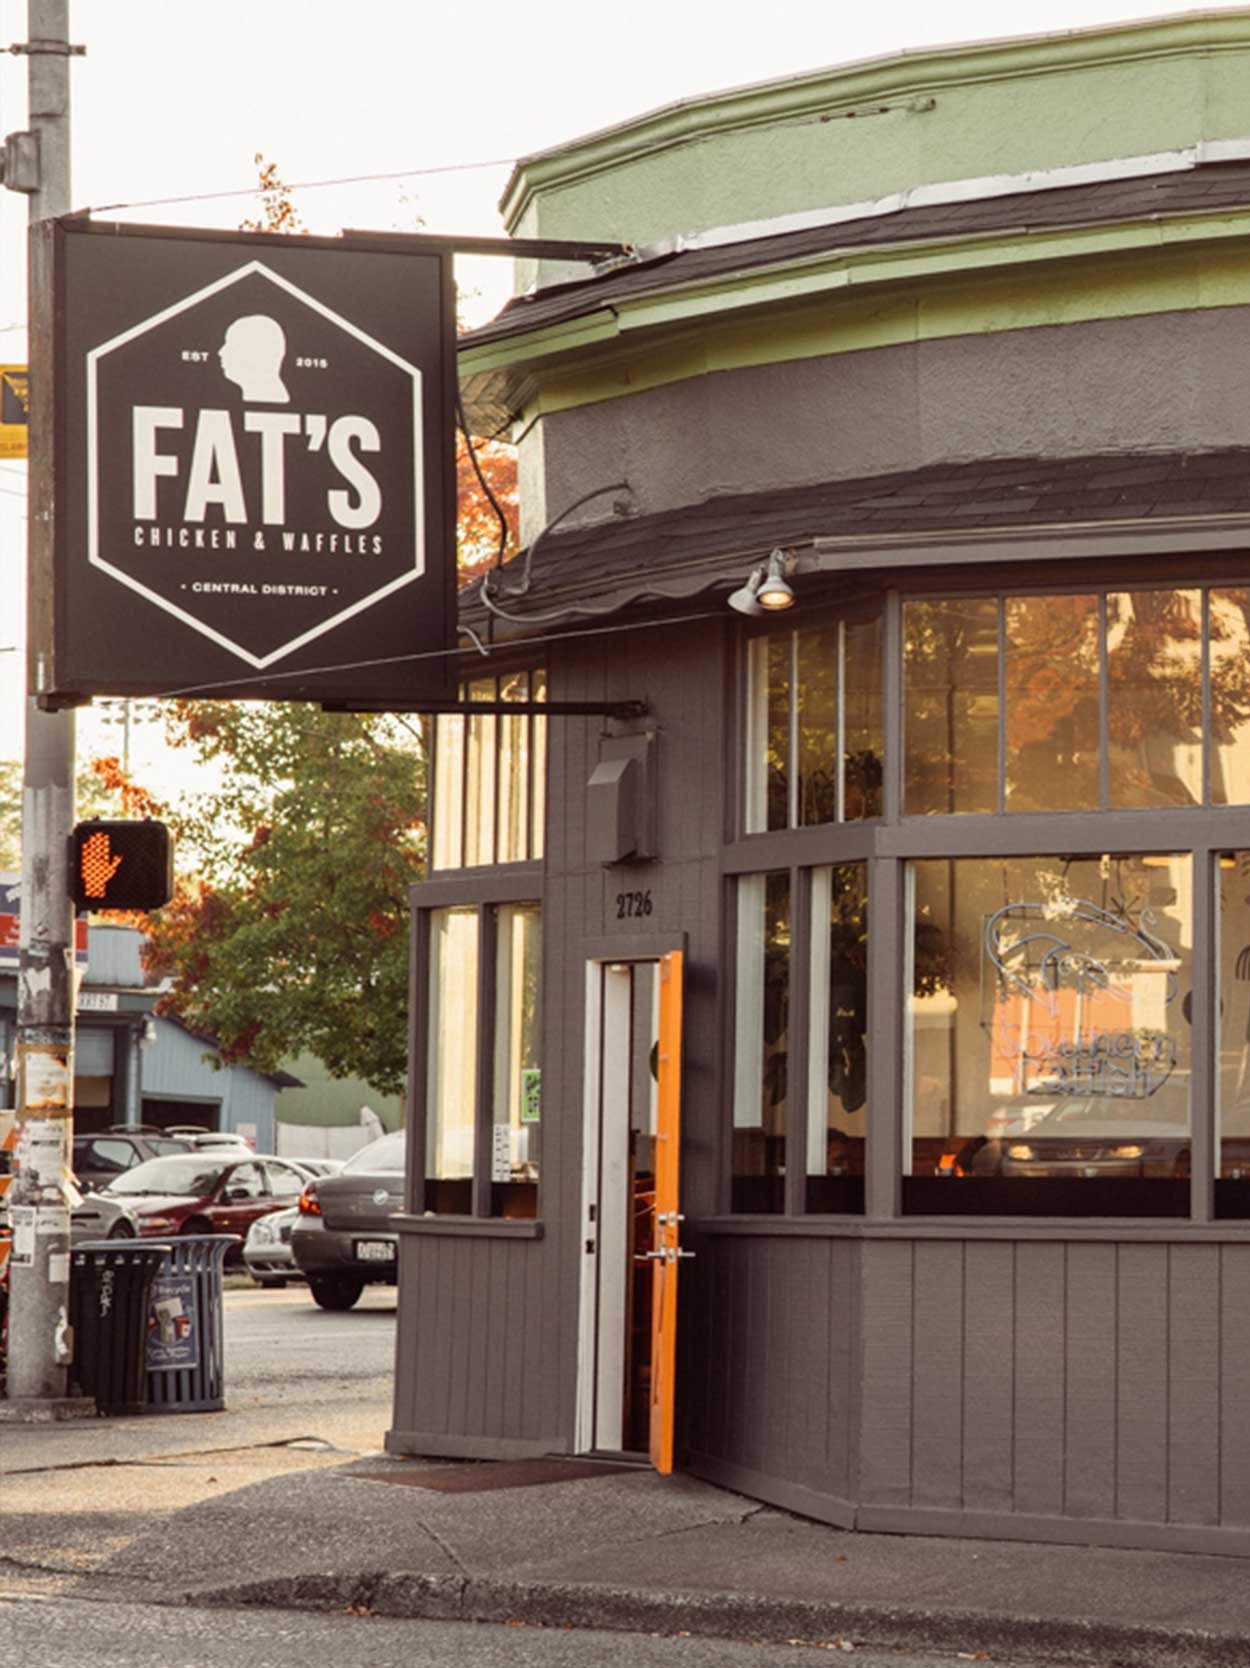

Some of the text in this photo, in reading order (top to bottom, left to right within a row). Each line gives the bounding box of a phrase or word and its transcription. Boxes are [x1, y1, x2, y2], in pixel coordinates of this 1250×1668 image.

[181, 350, 209, 362] EST
[132, 405, 383, 530] FAT'S
[133, 525, 383, 555] CHICKEN & WAFFLES
[191, 581, 328, 597] CENTRAL DISTRICT
[616, 889, 653, 920] 2726
